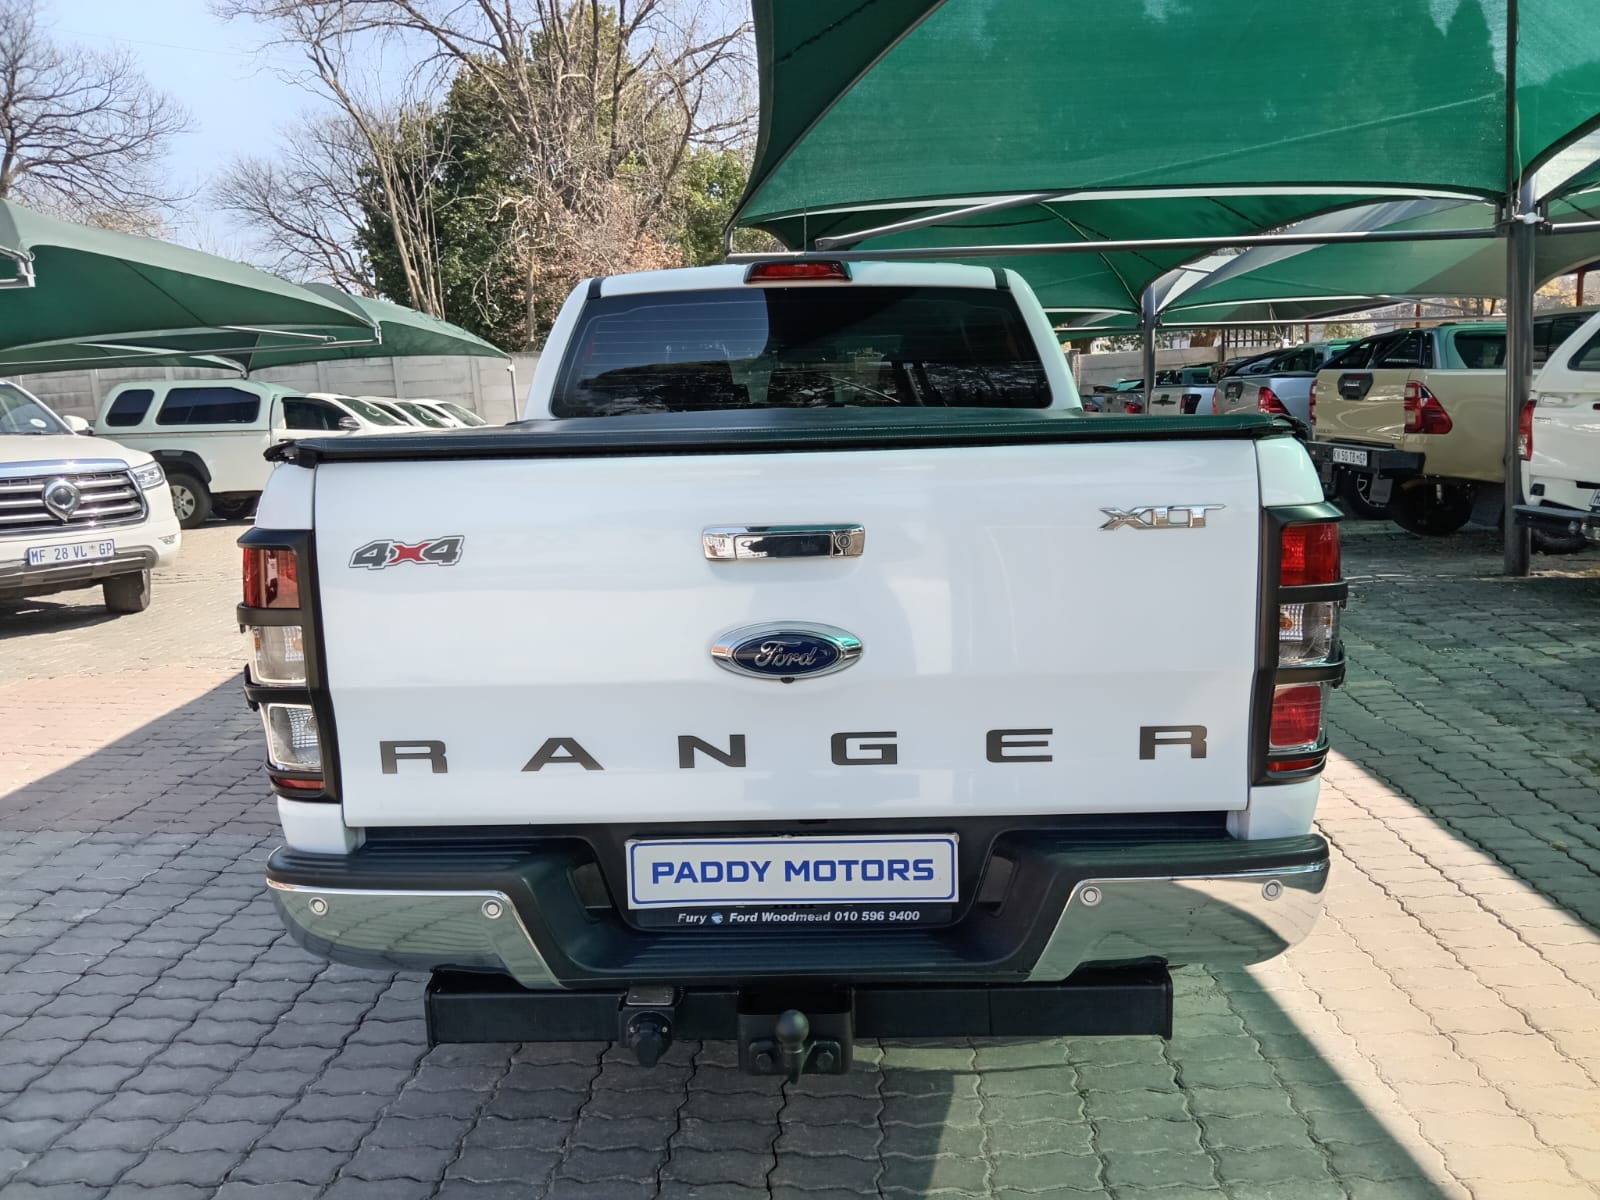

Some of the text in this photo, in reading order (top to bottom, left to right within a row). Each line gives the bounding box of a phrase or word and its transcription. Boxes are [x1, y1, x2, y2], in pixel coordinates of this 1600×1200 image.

[1098, 504, 1226, 531] XLT
[31, 542, 113, 563] MF 28 VL GP
[754, 640, 819, 668] Ford
[379, 724, 1208, 775] RANGER
[651, 858, 934, 885] PADDY MOTORS
[677, 909, 921, 926] Fury Ford Woodmead 010 596 9400
